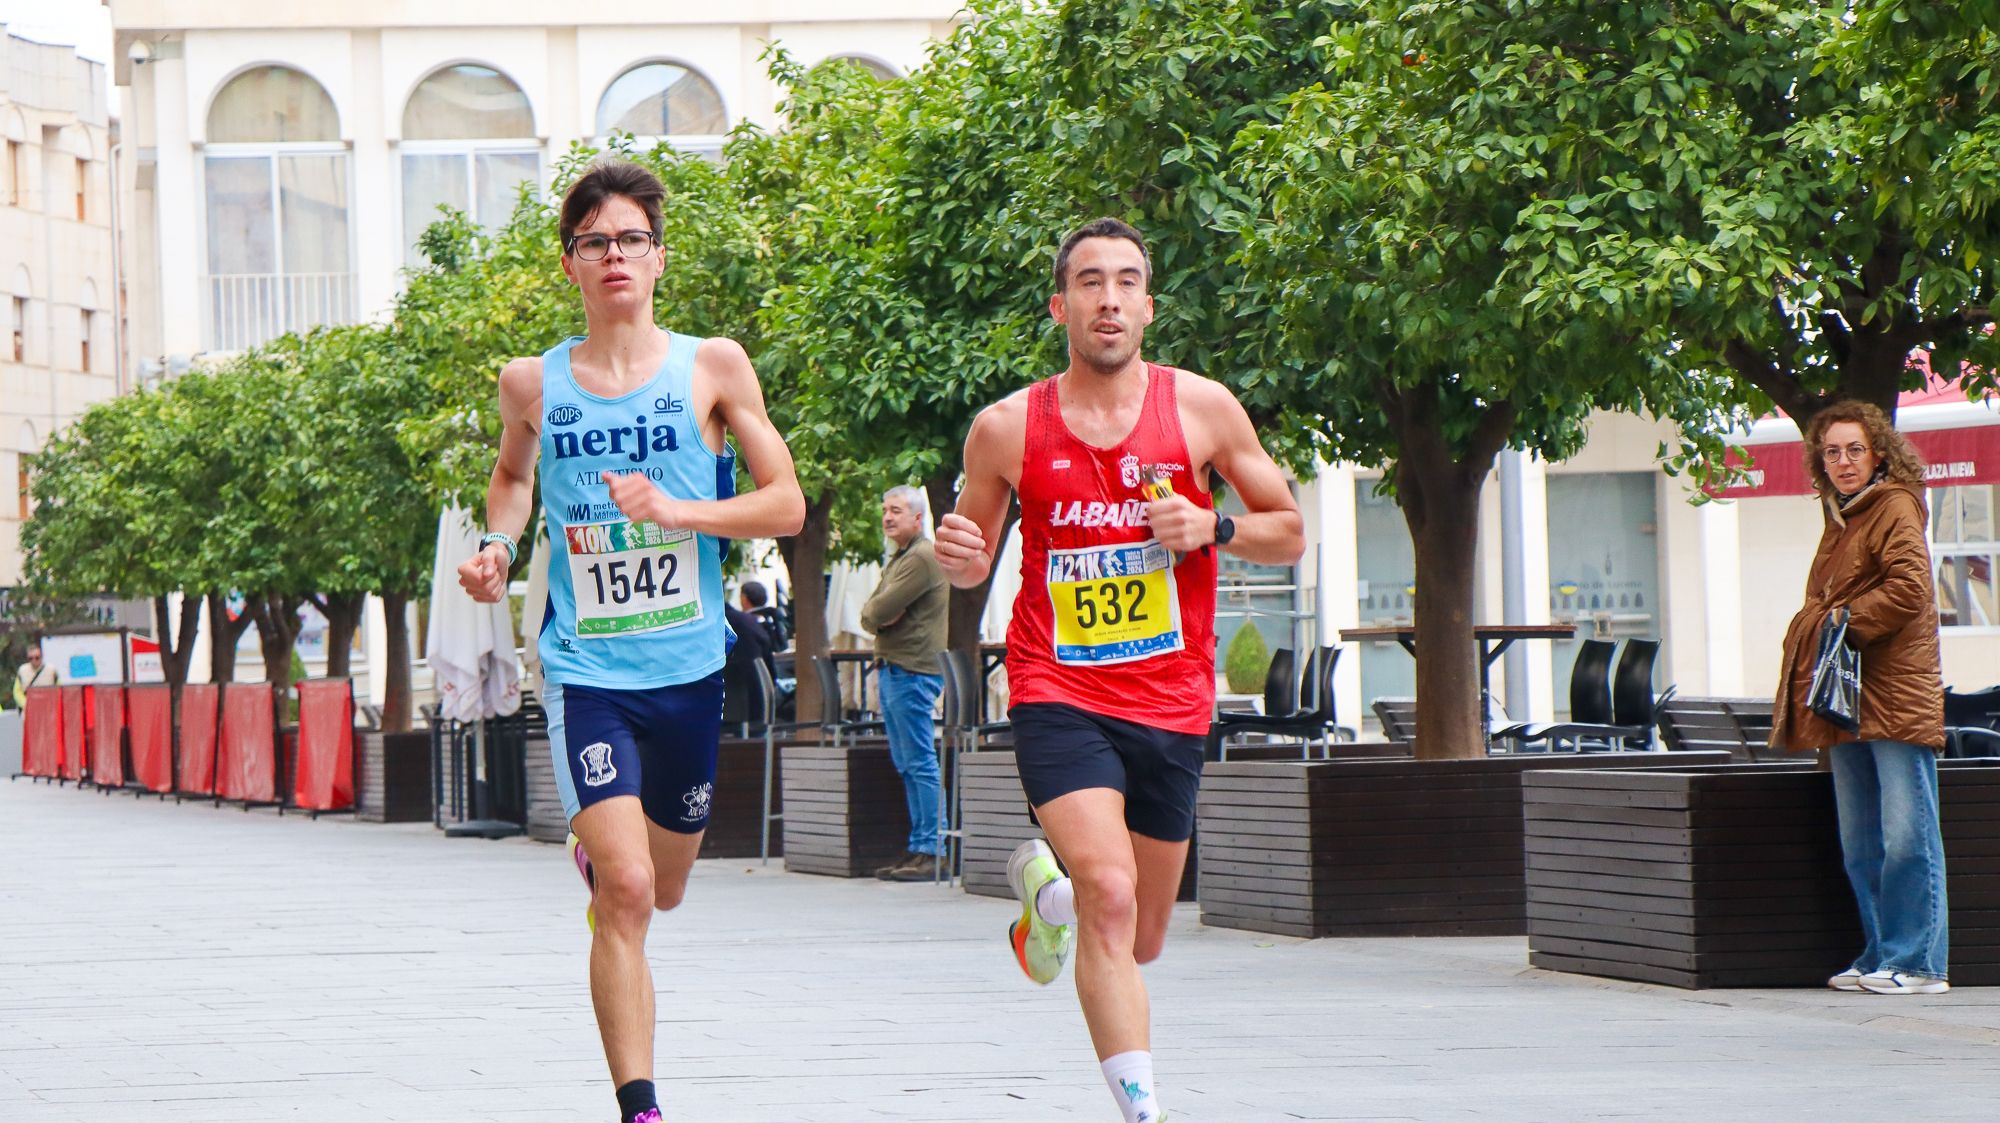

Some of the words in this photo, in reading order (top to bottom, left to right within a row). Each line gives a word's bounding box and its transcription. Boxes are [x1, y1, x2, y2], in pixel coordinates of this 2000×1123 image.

[550, 407, 580, 423] TROPS
[654, 392, 683, 413] als
[552, 415, 680, 463] nerja
[575, 467, 664, 487] ATLTIMO
[575, 525, 615, 554] 10K
[587, 553, 681, 604] 1542
[1075, 579, 1149, 629] 532
